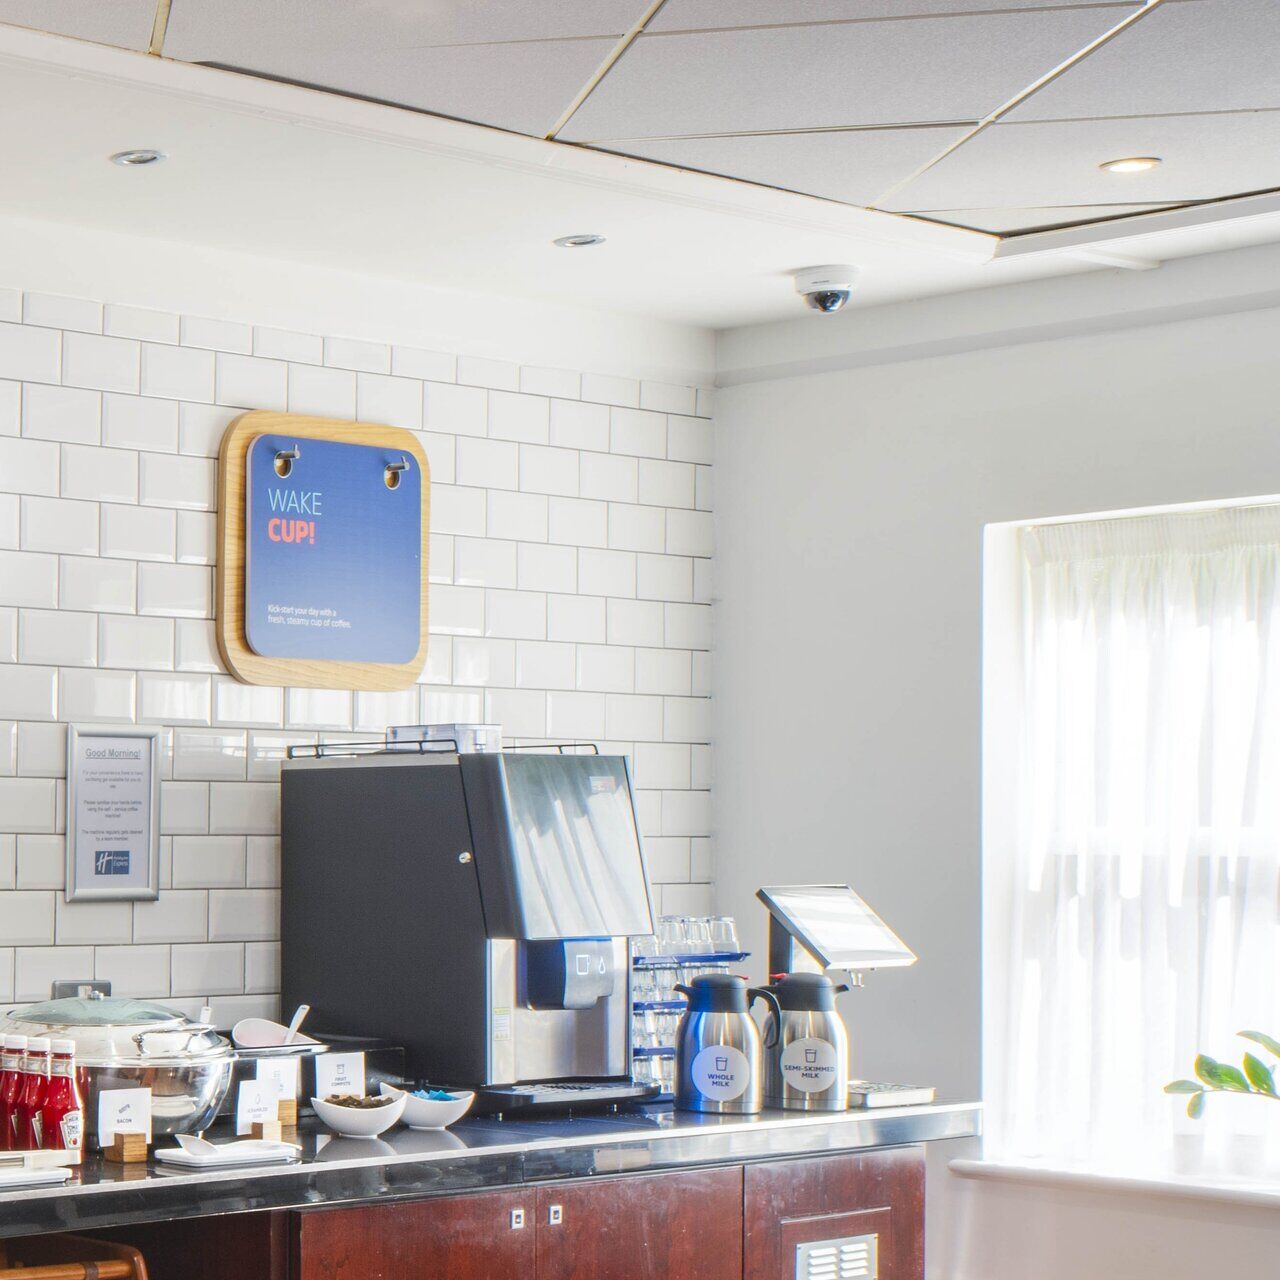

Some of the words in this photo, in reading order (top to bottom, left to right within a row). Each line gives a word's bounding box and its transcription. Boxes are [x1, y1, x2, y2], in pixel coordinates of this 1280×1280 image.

[267, 487, 323, 516] WAKE
[267, 517, 316, 545] CUP!
[294, 608, 307, 616] your
[308, 607, 319, 617] day
[310, 619, 323, 627] cup
[323, 619, 330, 627] of
[86, 748, 106, 758] Good
[109, 748, 141, 759] Morning!
[784, 1064, 836, 1073] SEMI-SKIMMED
[707, 1073, 735, 1081] WHOLE
